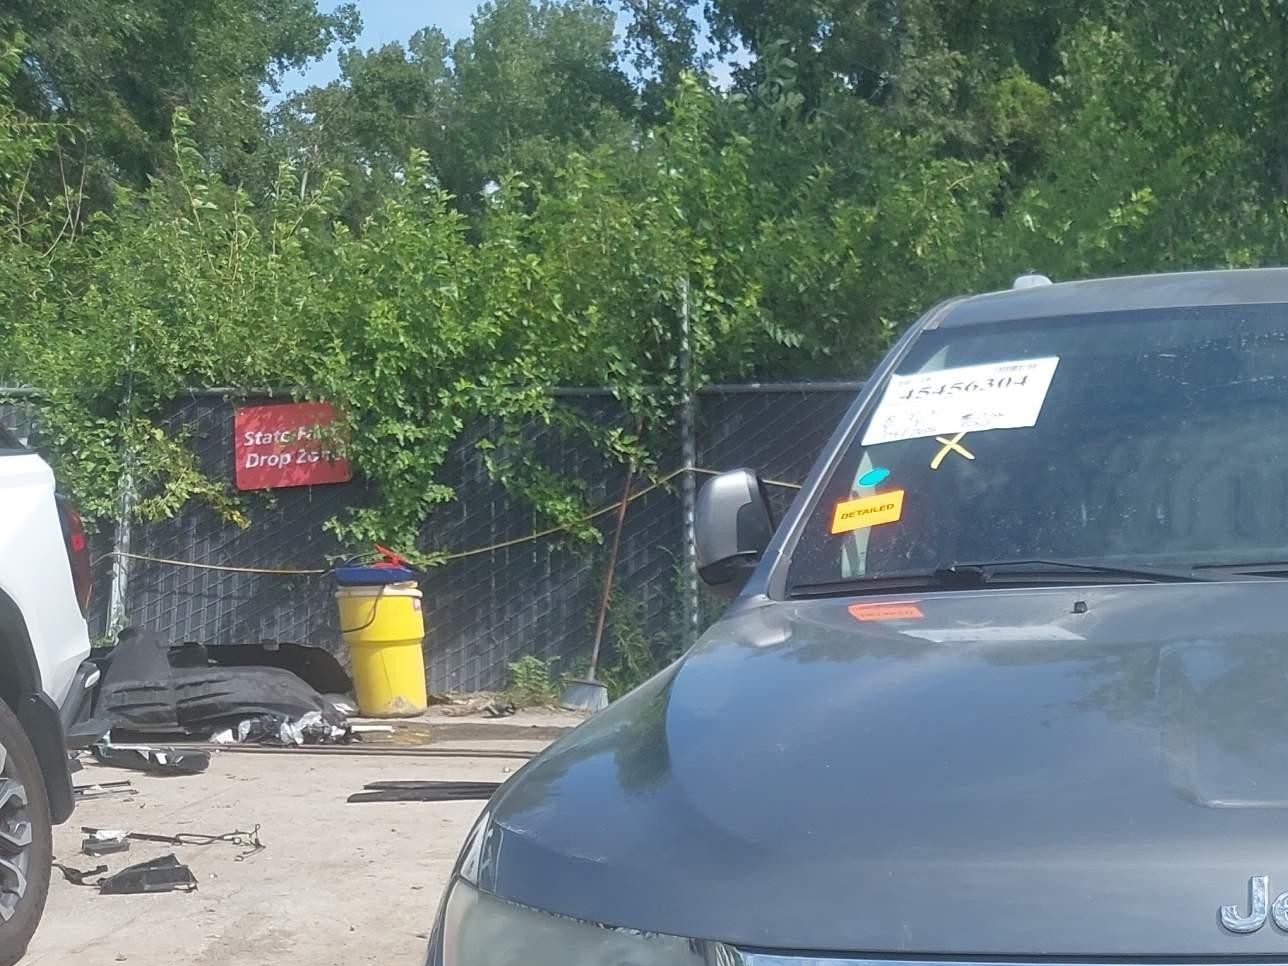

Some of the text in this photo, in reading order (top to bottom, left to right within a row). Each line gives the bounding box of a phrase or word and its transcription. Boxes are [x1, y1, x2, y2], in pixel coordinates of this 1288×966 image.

[899, 375, 1029, 400] 45456304
[245, 453, 292, 469] Drop
[840, 503, 895, 520] DETAILED
